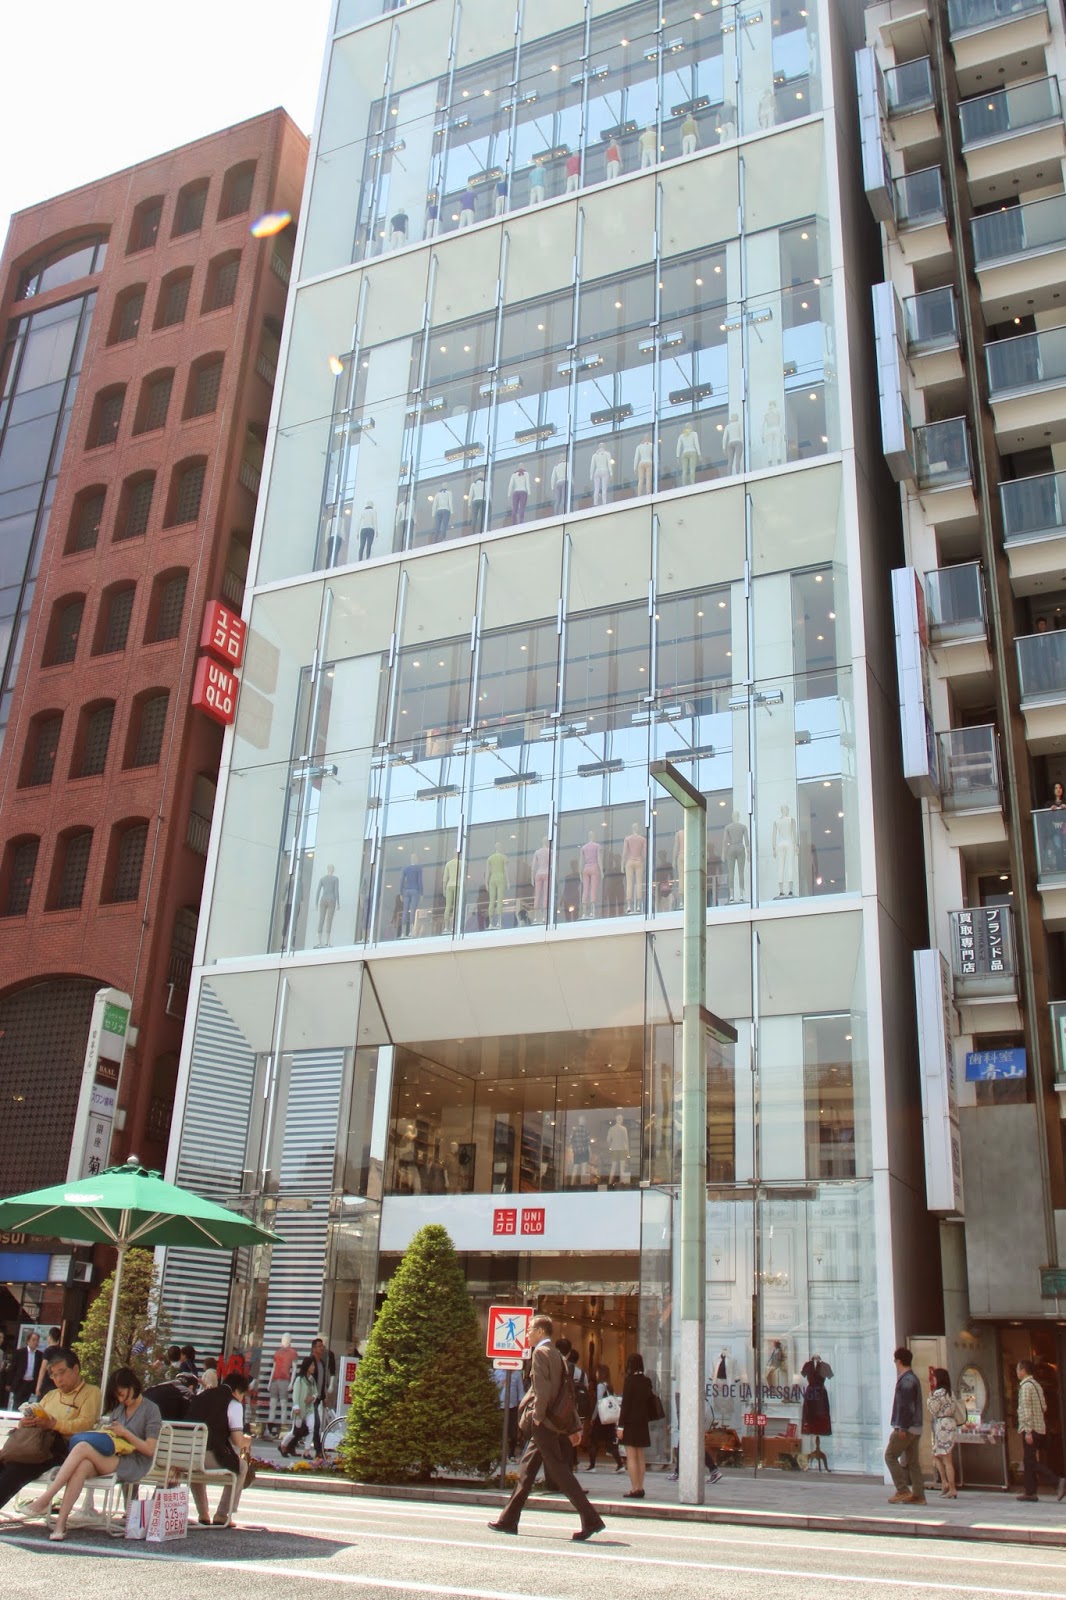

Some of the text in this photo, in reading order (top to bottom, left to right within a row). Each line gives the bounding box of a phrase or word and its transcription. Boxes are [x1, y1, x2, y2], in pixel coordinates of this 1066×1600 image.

[217, 609, 241, 639] ユニ
[213, 628, 239, 658] クロ
[208, 665, 232, 695] UNI
[206, 685, 232, 714] QLO
[959, 912, 975, 974] 買取専門店
[987, 909, 1003, 971] ブランド品
[968, 1051, 1014, 1066] 歯科室
[981, 1063, 1024, 1081] 青山
[496, 1212, 514, 1221] ユニ
[524, 1211, 541, 1221] UNI
[495, 1223, 514, 1232] クロ
[523, 1222, 542, 1233] QLO
[0, 1232, 25, 1245] SUI
[722, 1383, 736, 1398] DE
